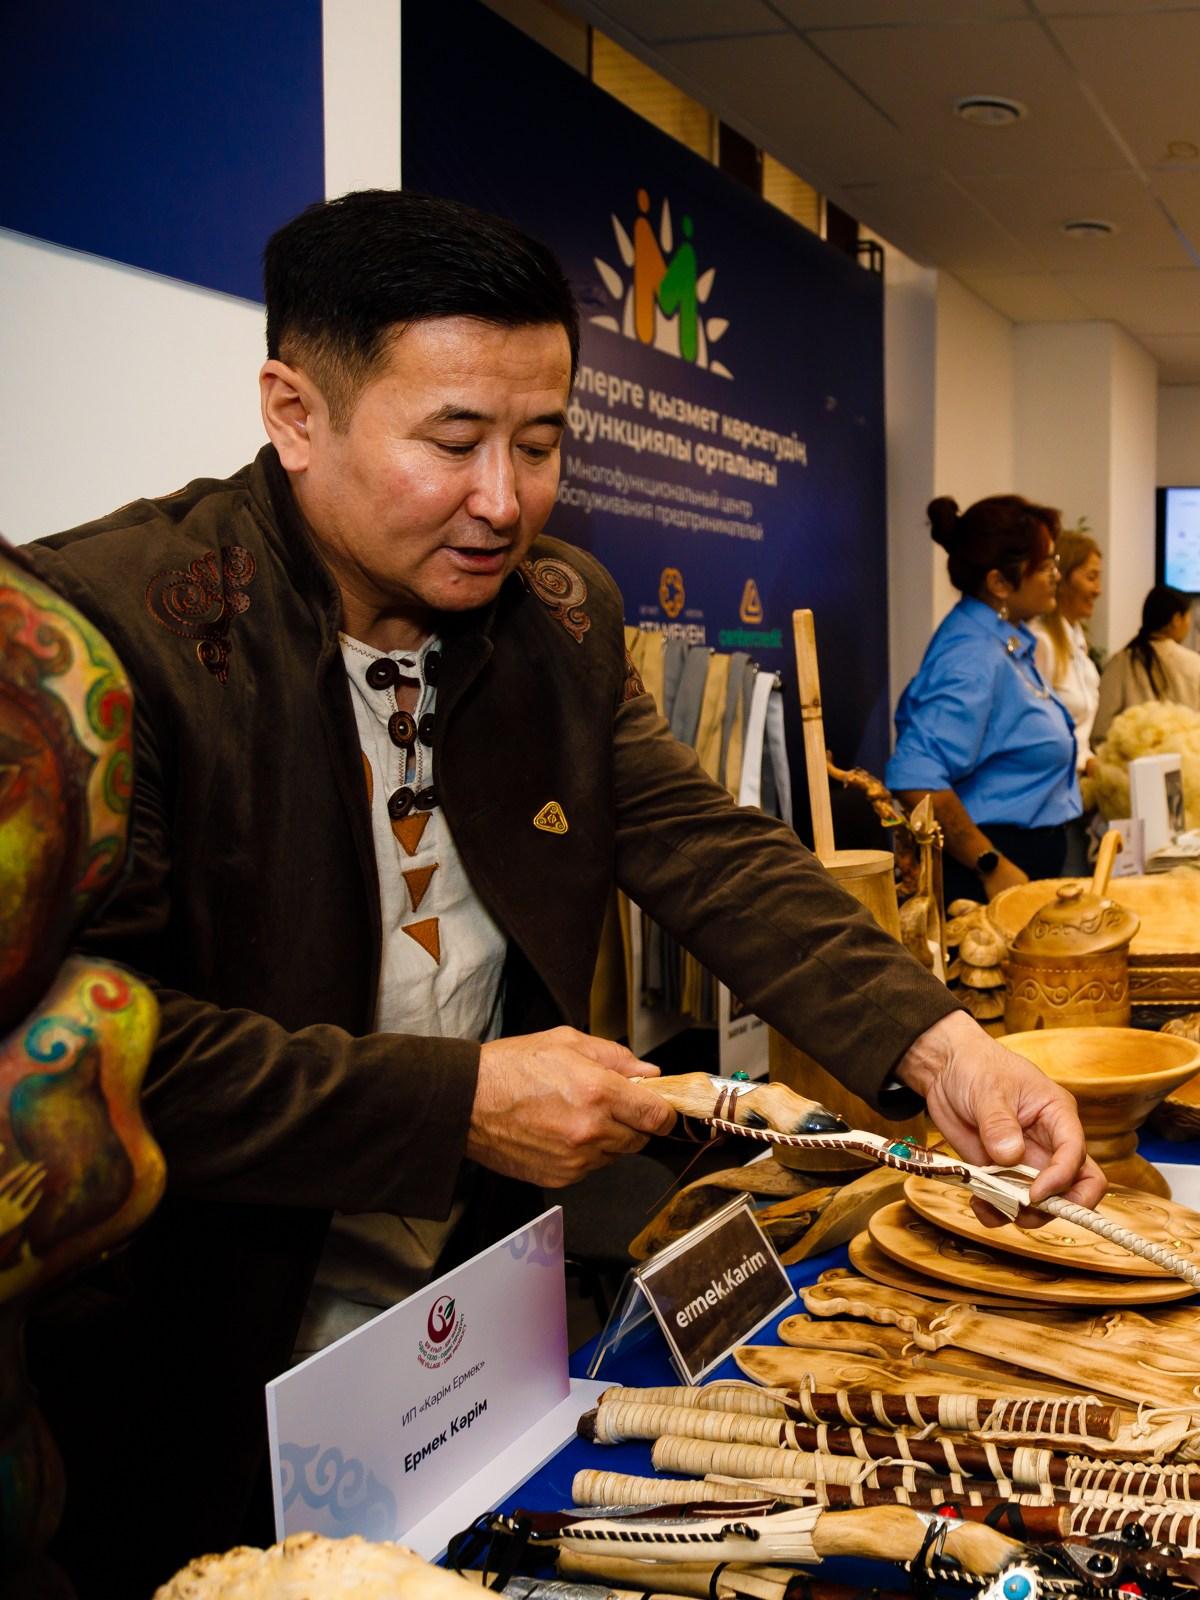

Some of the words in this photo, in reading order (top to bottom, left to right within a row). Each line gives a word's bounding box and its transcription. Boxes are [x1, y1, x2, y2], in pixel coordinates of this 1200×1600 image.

[649, 388, 720, 433] қызмет
[722, 414, 808, 467] көрсетудің
[695, 443, 778, 486] орталығы
[558, 480, 654, 519] бслуживания
[402, 1406, 417, 1427] ИП
[419, 1384, 452, 1413] «Кәрім
[452, 1360, 486, 1389] Ермек»
[404, 1430, 447, 1473] Ермек
[450, 1399, 488, 1437] Кәрім
